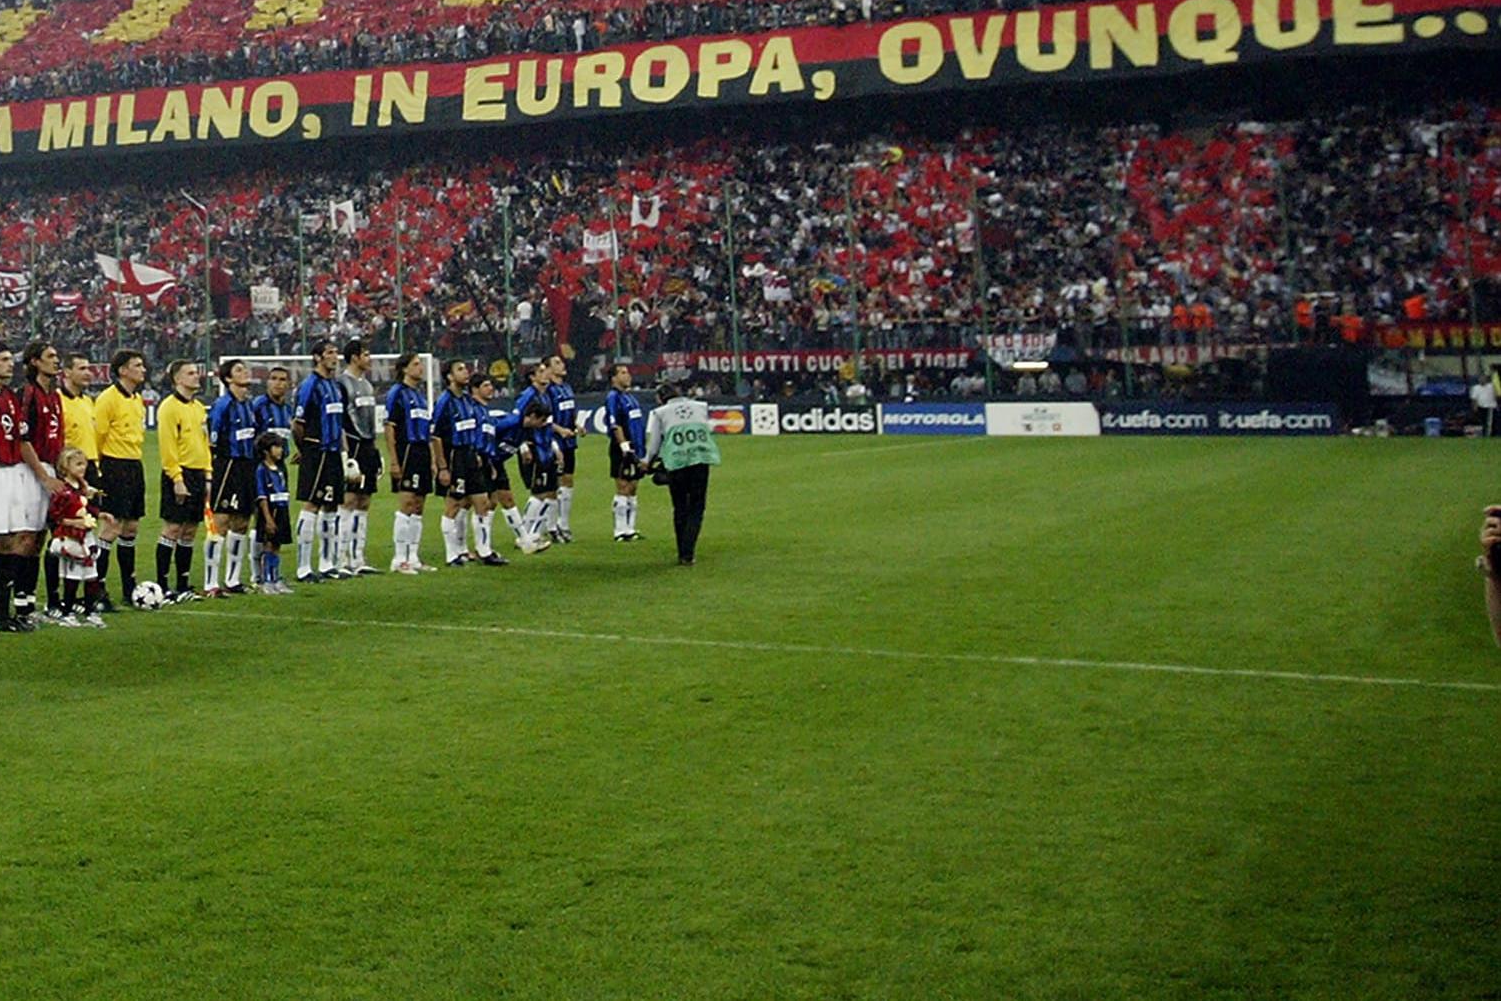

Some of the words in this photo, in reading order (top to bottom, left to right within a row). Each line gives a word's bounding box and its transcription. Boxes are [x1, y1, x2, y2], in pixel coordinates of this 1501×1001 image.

[37, 81, 321, 151] MILANO,
[351, 71, 428, 126] IN
[463, 36, 836, 121] EUROPA,
[806, 354, 867, 372] CUOE
[782, 408, 874, 431] adidas
[884, 412, 985, 425] MOTOROLA
